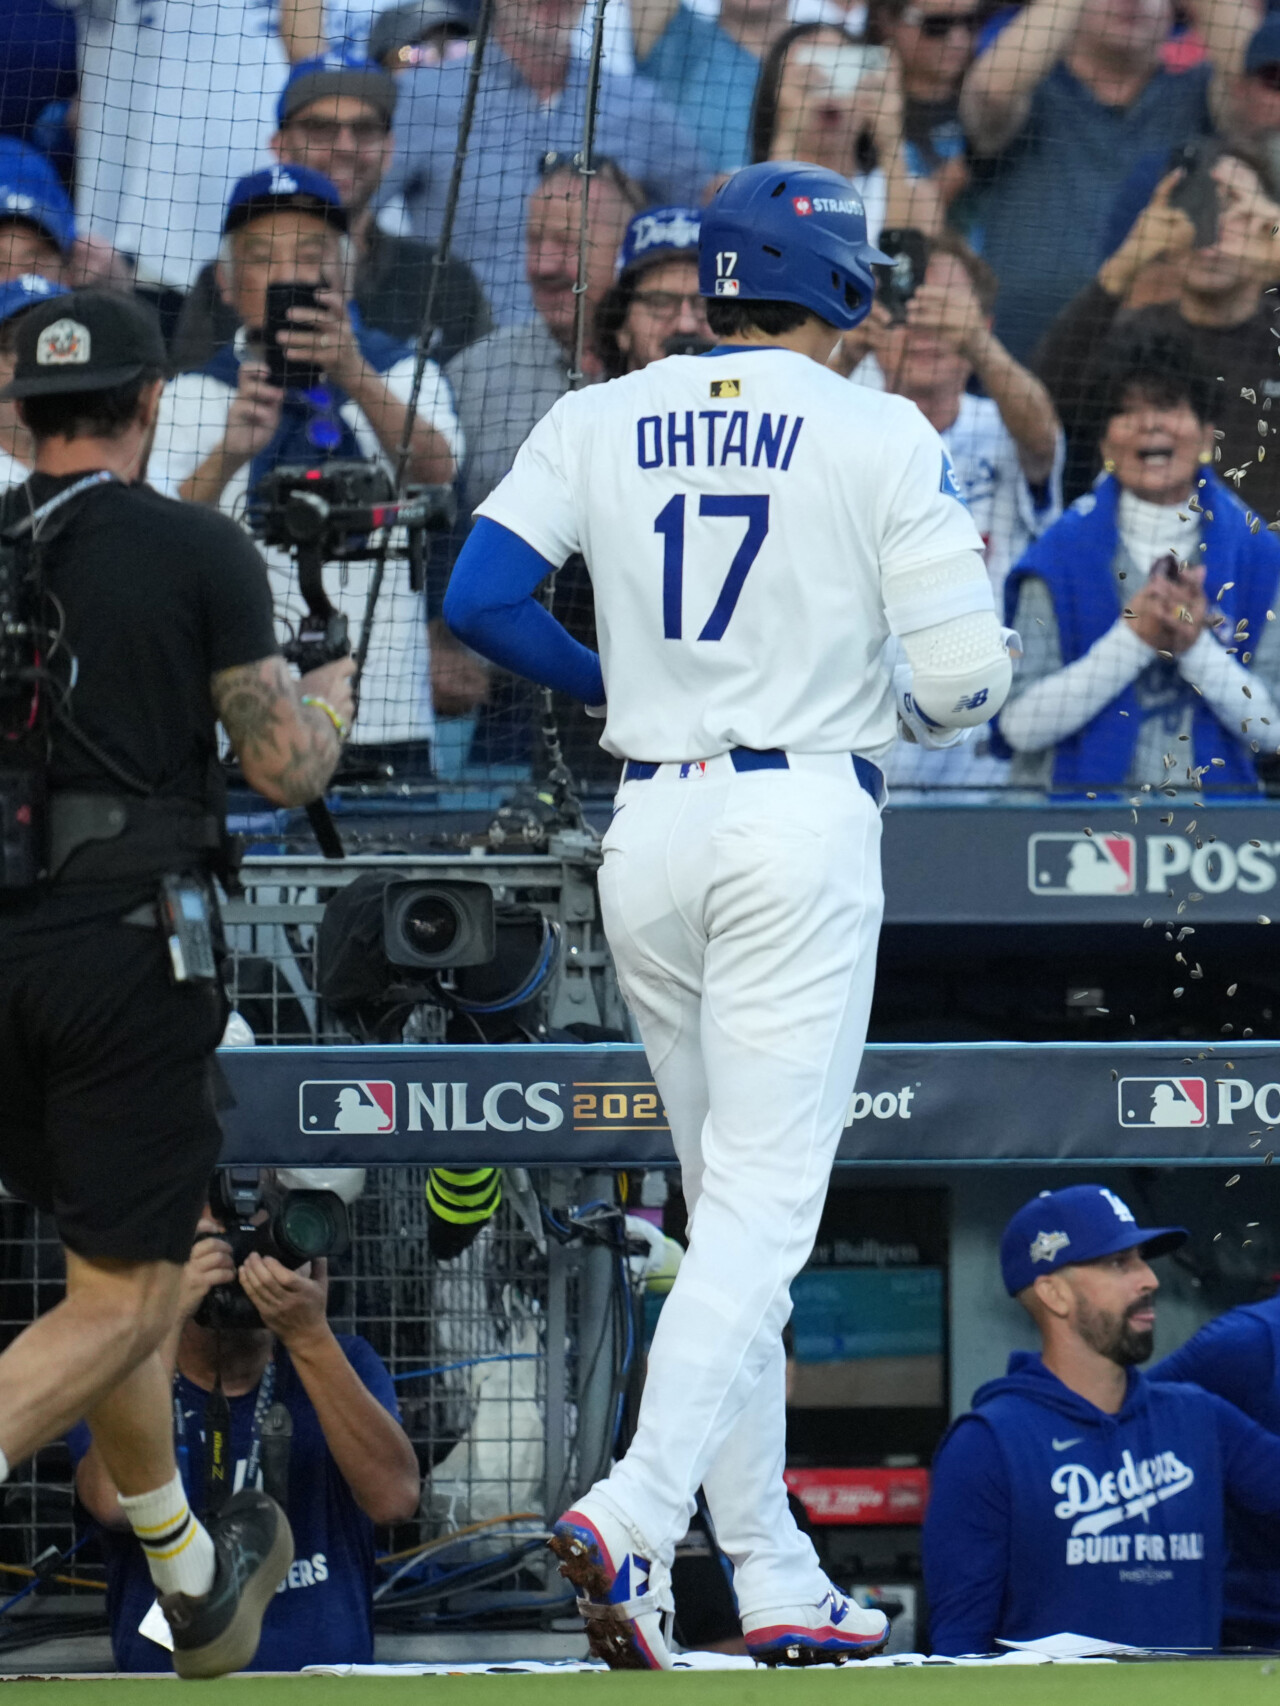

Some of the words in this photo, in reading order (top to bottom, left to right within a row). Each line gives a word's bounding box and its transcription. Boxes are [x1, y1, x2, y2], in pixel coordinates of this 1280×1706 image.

[715, 252, 738, 277] 17
[637, 411, 804, 471] OHTANI
[654, 494, 770, 642] 17
[406, 1081, 564, 1132] NLCS
[1066, 1534, 1131, 1566] BUILT
